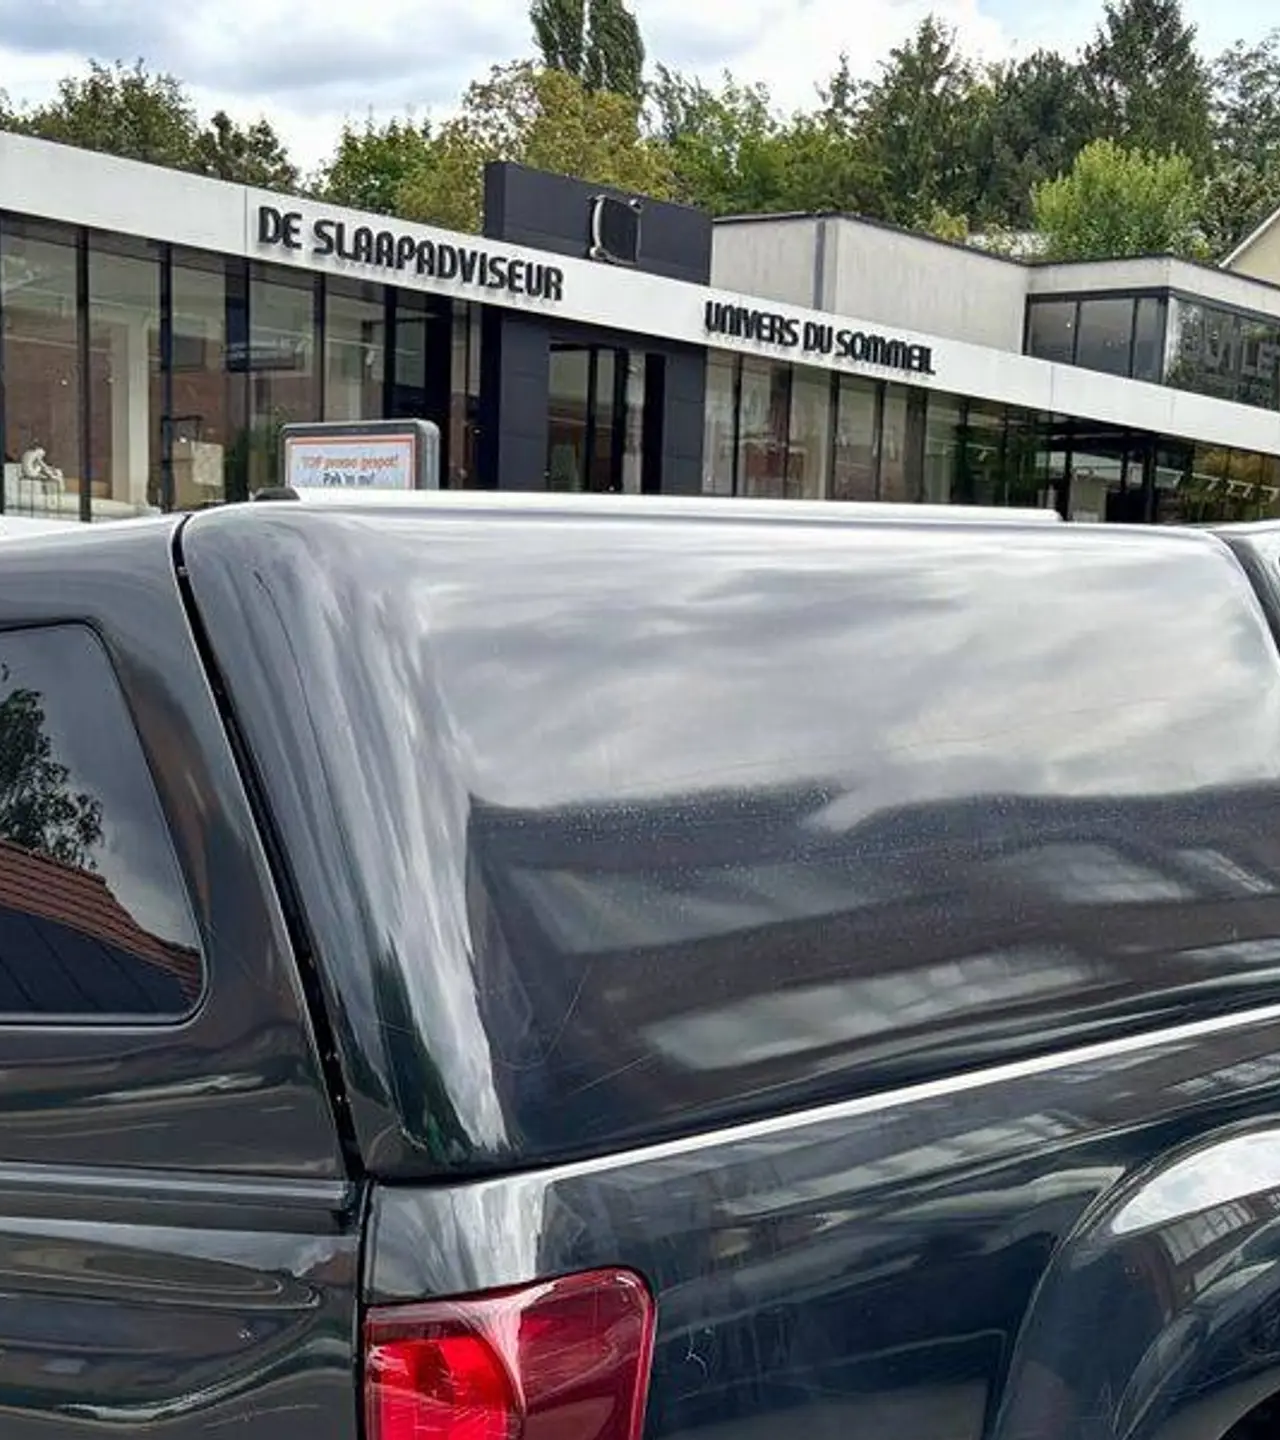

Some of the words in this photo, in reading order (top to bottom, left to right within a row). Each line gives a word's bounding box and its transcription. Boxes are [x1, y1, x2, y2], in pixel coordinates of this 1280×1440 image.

[258, 206, 302, 249] DE
[313, 219, 564, 301] SLAAPADVISEUR
[705, 300, 800, 347] UNIVERS
[803, 321, 833, 354] DU
[835, 329, 936, 375] SOMMEIL
